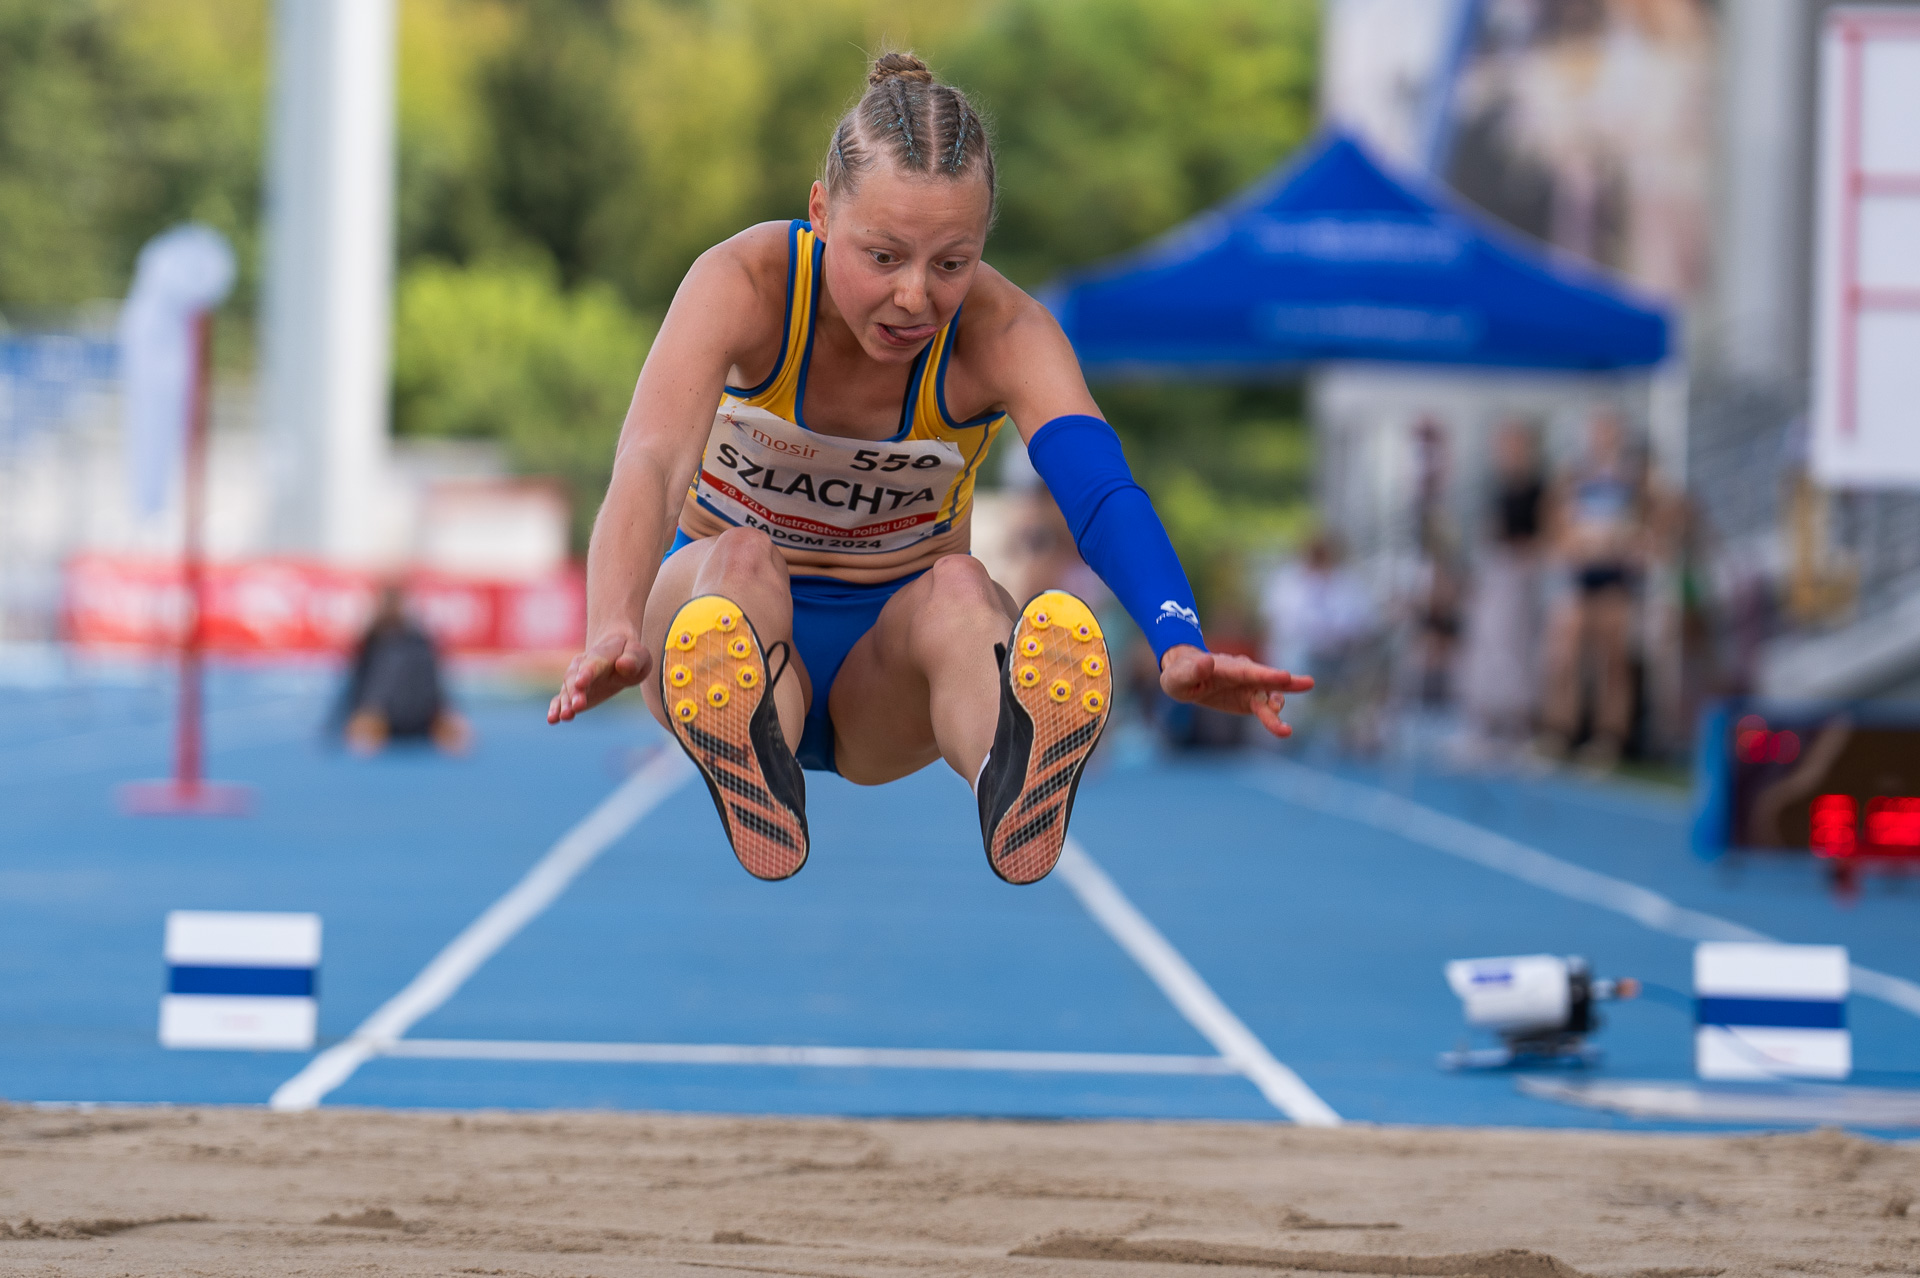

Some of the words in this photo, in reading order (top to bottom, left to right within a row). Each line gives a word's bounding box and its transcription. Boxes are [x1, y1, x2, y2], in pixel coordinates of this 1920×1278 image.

[752, 428, 819, 458] mosir
[716, 442, 935, 515] SZLACHTA
[721, 483, 740, 500] 78.
[740, 494, 768, 518] PZLA
[770, 513, 850, 538] Mistrzostwa
[852, 522, 890, 538] Polski
[892, 516, 917, 531] U20
[744, 514, 824, 547] RADOM
[829, 538, 882, 549] 2024
